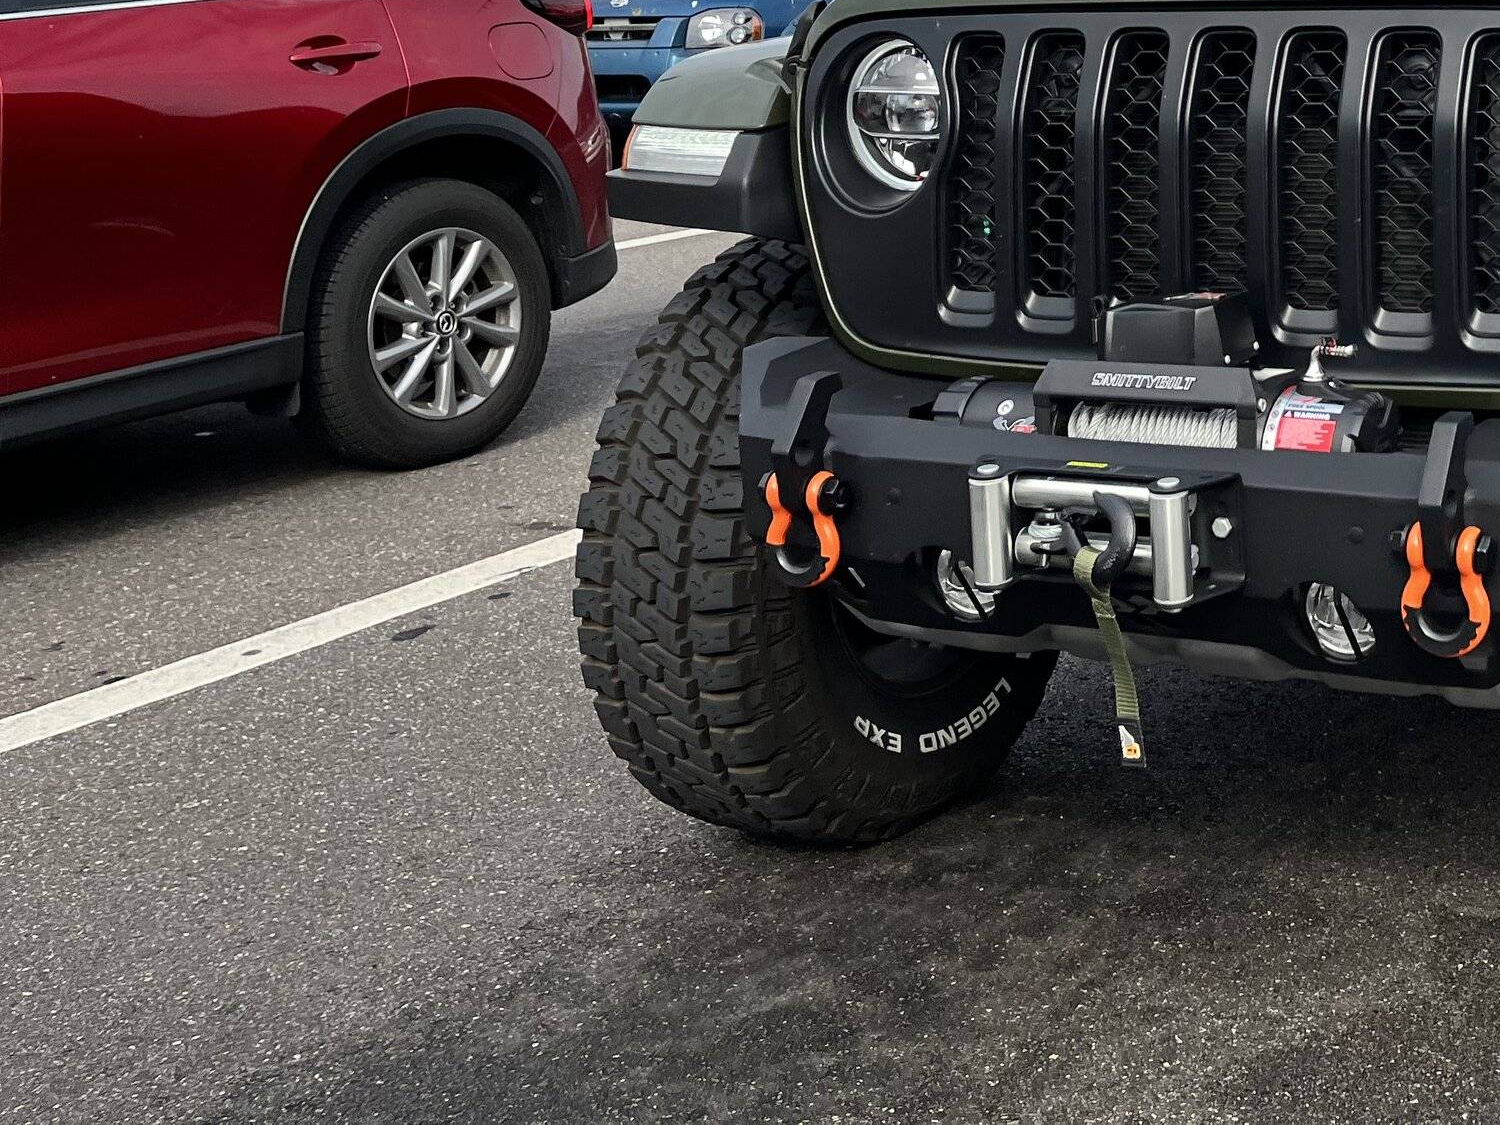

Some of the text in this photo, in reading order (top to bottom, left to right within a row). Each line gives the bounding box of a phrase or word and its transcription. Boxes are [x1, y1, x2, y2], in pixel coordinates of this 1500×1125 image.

[1091, 372, 1197, 391] SMITTYBILT
[1293, 411, 1331, 421] WARNING
[853, 677, 1012, 754] LEGEND EXP
